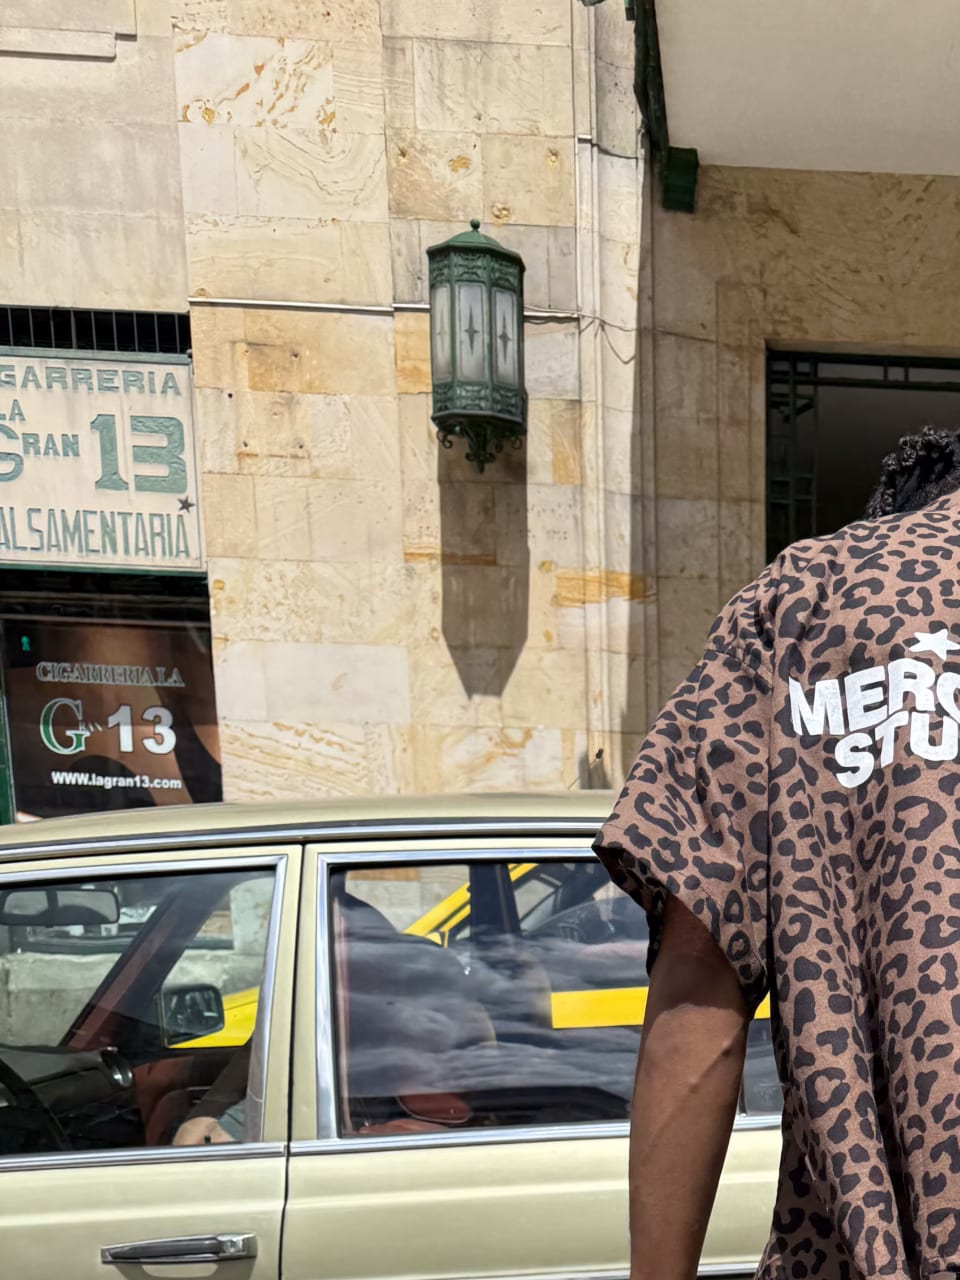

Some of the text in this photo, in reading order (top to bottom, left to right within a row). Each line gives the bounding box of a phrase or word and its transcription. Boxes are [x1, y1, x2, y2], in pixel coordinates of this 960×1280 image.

[0, 398, 26, 422] A
[90, 413, 188, 494] 13
[107, 704, 177, 755] 13
